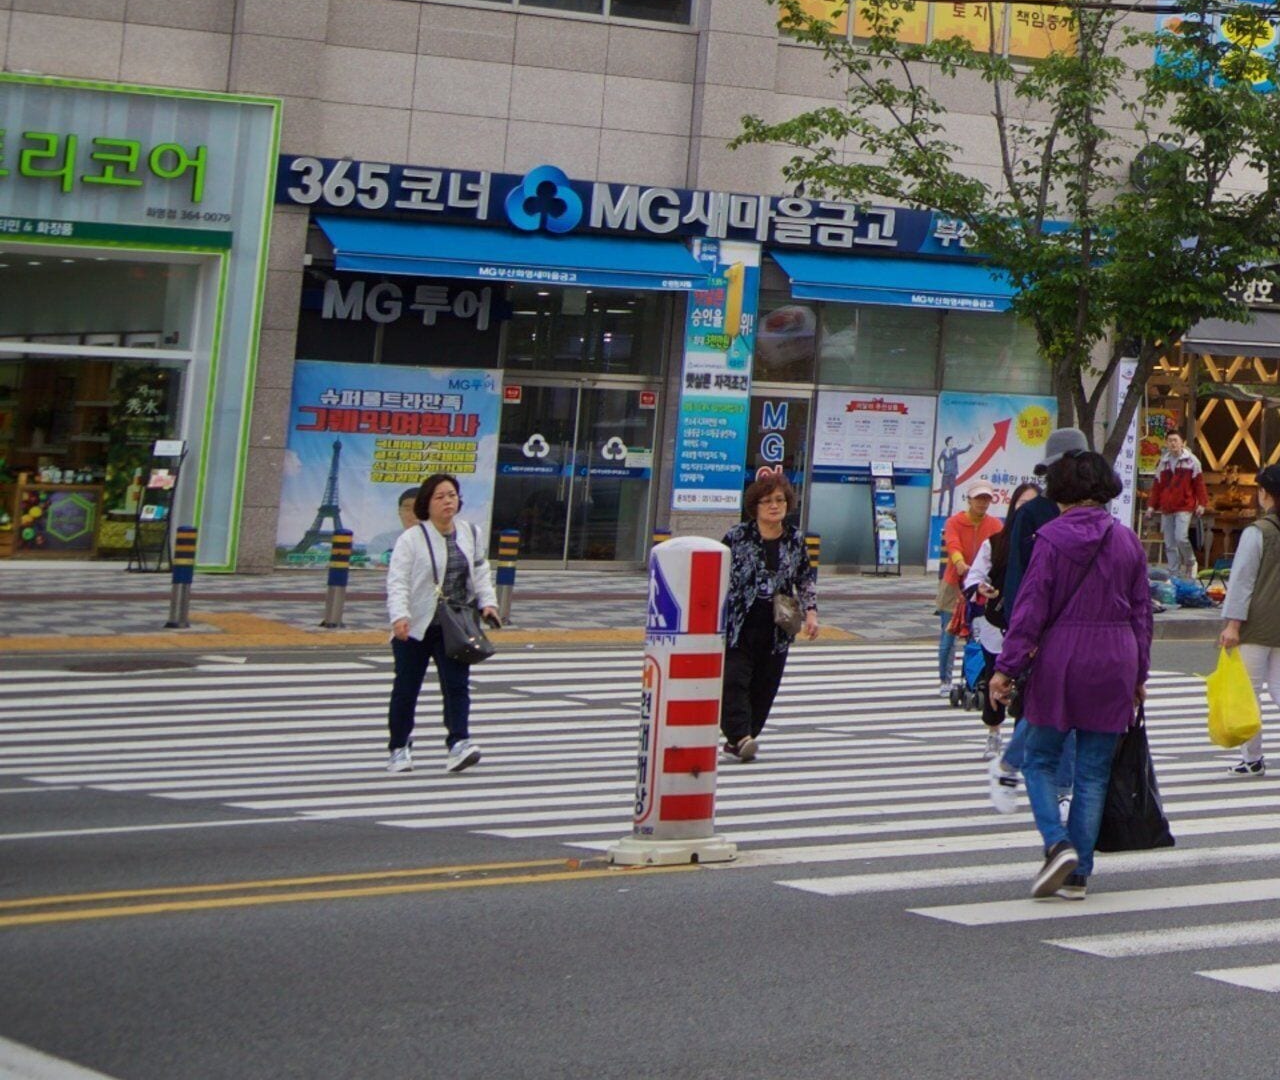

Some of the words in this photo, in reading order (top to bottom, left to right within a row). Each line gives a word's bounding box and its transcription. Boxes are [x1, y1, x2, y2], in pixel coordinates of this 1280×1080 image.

[181, 209, 231, 223] 364-0079
[37, 223, 74, 236] 화장품
[321, 278, 402, 323] MG
[410, 283, 491, 331] 투어
